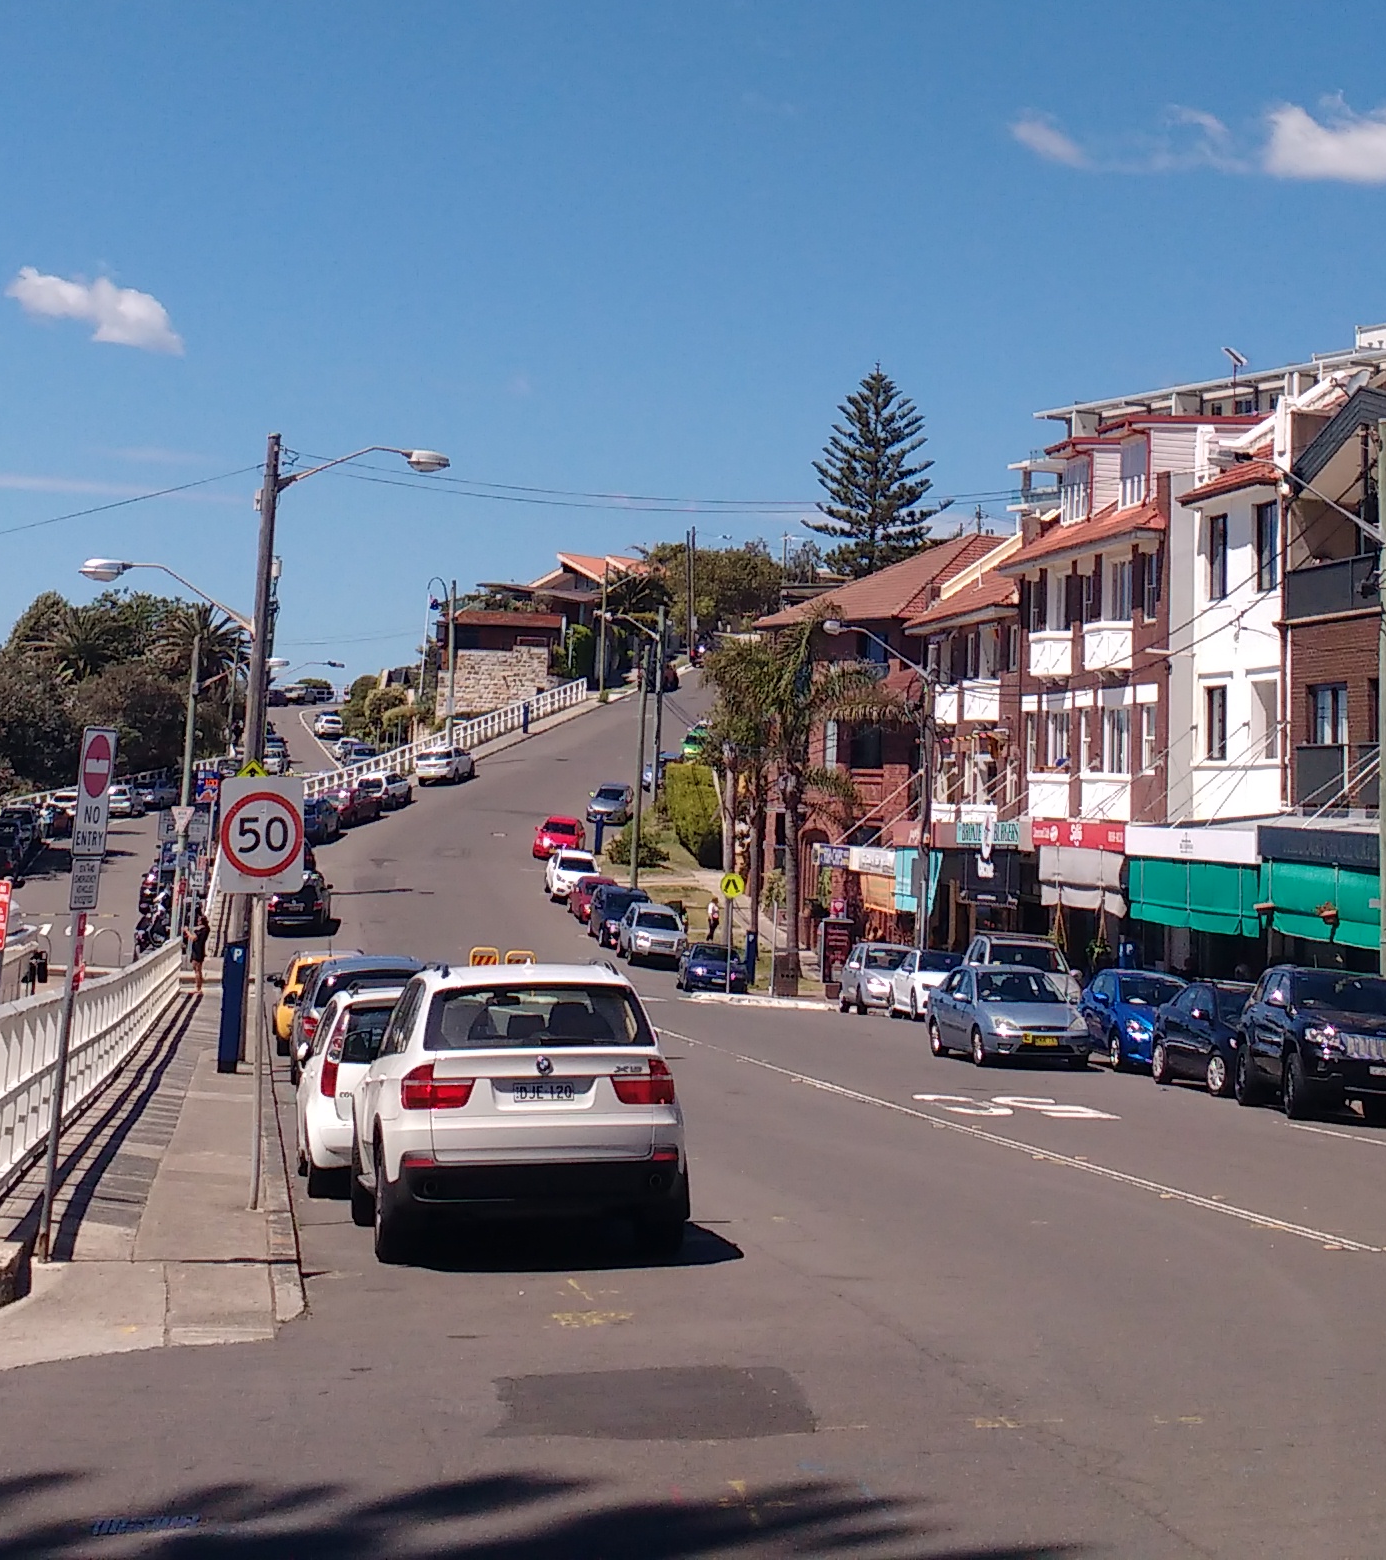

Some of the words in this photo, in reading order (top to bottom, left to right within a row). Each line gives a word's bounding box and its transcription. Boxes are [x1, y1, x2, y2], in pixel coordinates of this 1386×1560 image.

[84, 805, 101, 825] NO
[76, 831, 104, 847] ENTRY
[237, 817, 289, 853] 50
[234, 948, 243, 961] P
